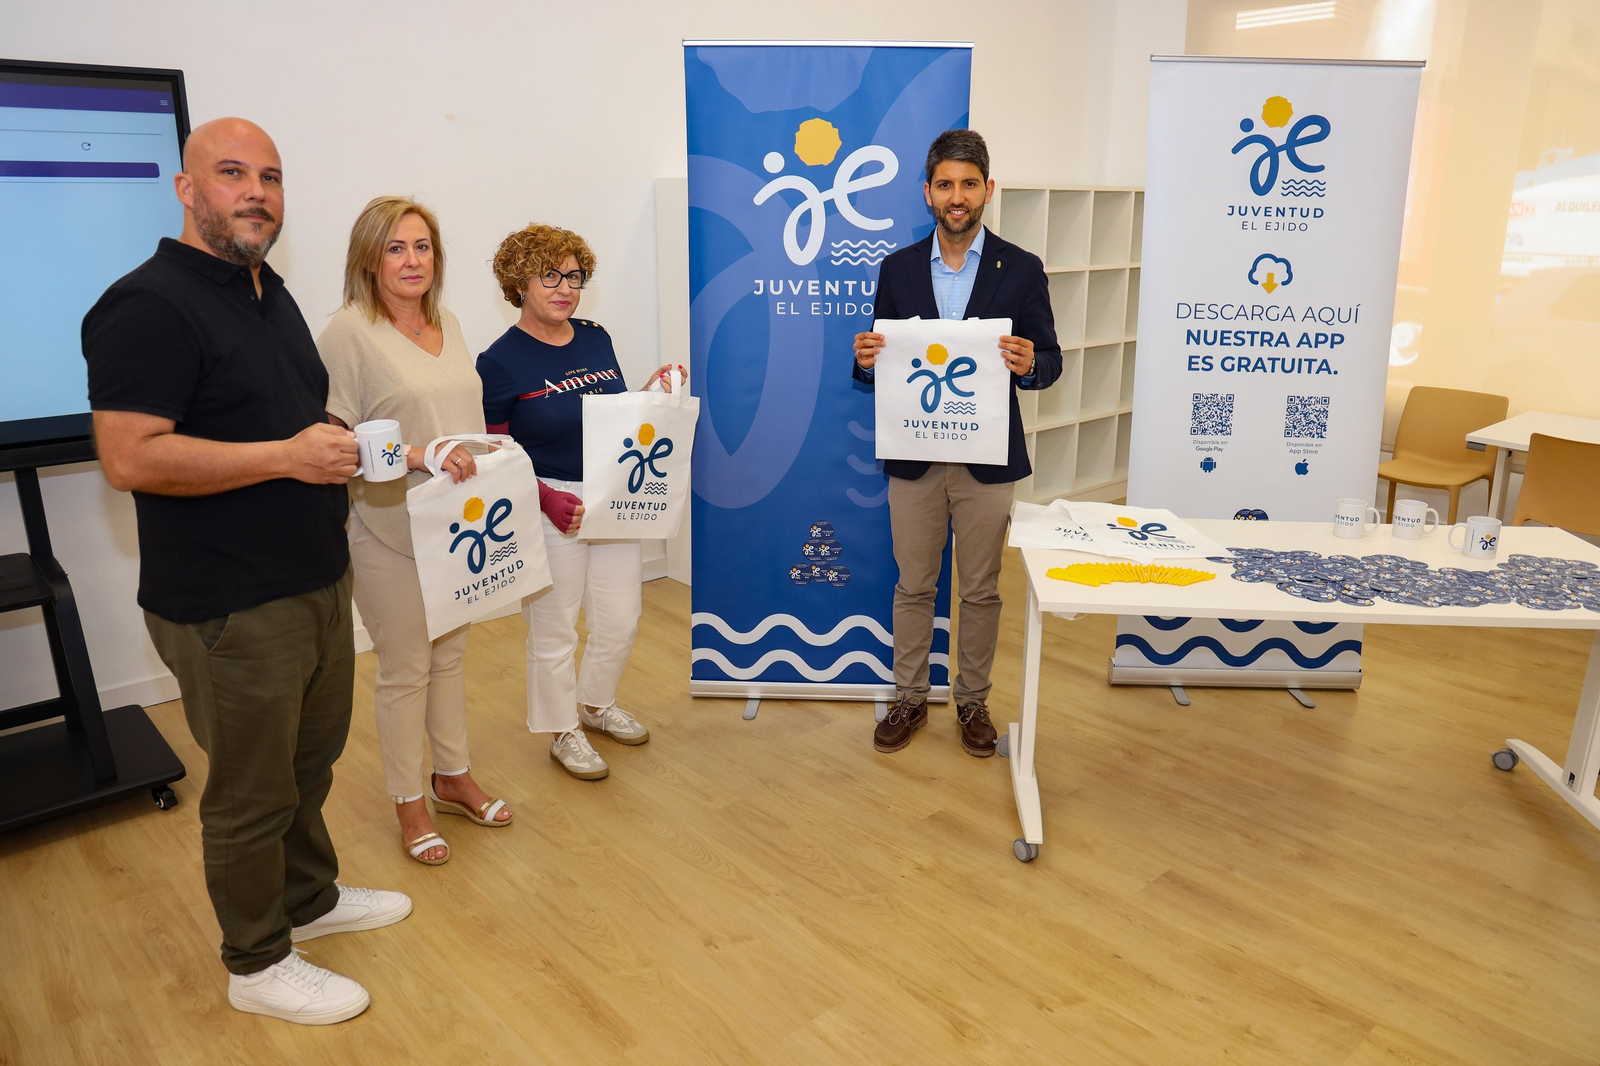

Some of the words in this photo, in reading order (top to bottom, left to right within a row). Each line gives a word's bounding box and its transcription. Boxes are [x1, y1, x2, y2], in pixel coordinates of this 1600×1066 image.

[1227, 205, 1324, 218] JUVENTUD
[1241, 221, 1257, 231] EL
[1265, 222, 1308, 232] EJIDO
[753, 279, 876, 297] JUVENTU
[776, 302, 800, 315] EL
[811, 302, 874, 316] EJIDO
[1176, 302, 1296, 323] DESCARGA
[1301, 304, 1361, 326] AQUÍ
[1186, 329, 1291, 348] NUESTRA
[1296, 332, 1345, 349] APP
[1187, 355, 1214, 372] ES
[1220, 356, 1339, 375] GRATUITA.
[544, 368, 618, 398] Amour
[903, 419, 979, 431] JUVENTUD
[915, 431, 928, 439] EL
[933, 432, 968, 441] EJIDO
[610, 501, 668, 511] JUVENTUD
[630, 513, 658, 521] EJIDO
[1335, 514, 1360, 522] VENTUD
[1395, 515, 1421, 524] VENTUD
[1055, 527, 1090, 538] JUVE
[454, 560, 524, 600] JUVENTUD
[467, 594, 480, 604] EL
[484, 576, 516, 596] EJIDO
